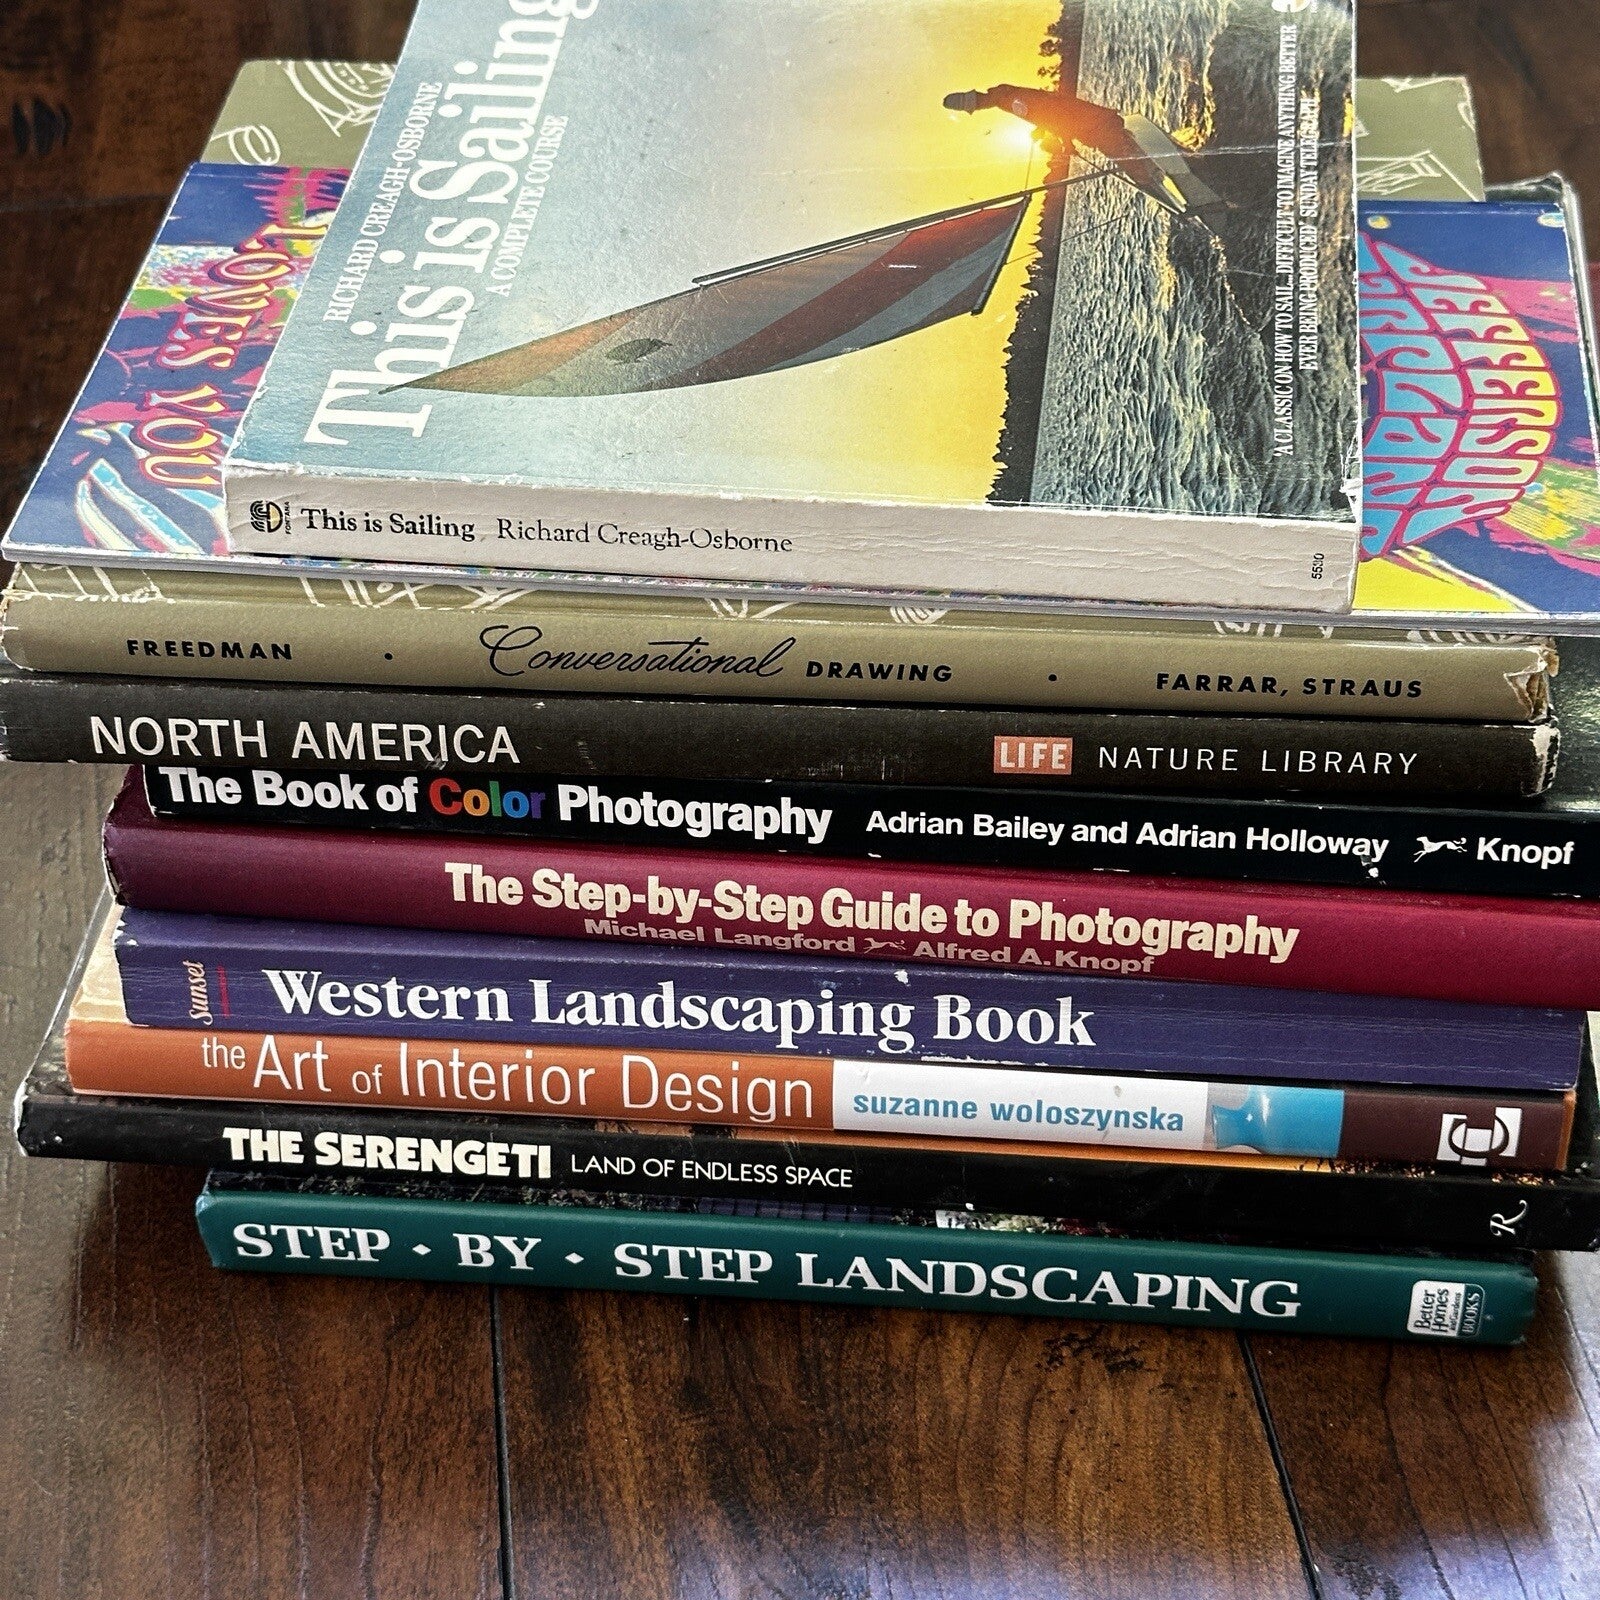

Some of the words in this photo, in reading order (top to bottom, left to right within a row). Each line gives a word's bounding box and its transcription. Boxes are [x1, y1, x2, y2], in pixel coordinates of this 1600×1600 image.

[1279, 24, 1298, 74] BETTER
[1277, 74, 1297, 139] ANYTHING
[525, 115, 570, 184] COURSE
[1299, 98, 1319, 168] TELEGRAPH
[1277, 138, 1296, 192] IMAGINE
[322, 239, 379, 323] RICHARD
[360, 82, 443, 237] CREAGH-OSBORNE
[1276, 191, 1295, 210] TO
[1299, 166, 1318, 218] SUNDAY
[379, 217, 501, 273] is
[490, 186, 547, 281] COMPLETE
[155, 224, 329, 371] LOVES
[486, 286, 511, 297] A
[1299, 290, 1319, 334] BEING
[1274, 333, 1294, 363] HOW
[1275, 312, 1294, 333] TO
[304, 284, 475, 447] This
[1274, 364, 1294, 385] ON
[1299, 334, 1319, 371] EVER
[1273, 386, 1294, 442] CLASSIC
[1374, 241, 1559, 545] JEFFERSON
[136, 383, 228, 487] YOU
[300, 508, 358, 533] This
[364, 513, 382, 533] is
[390, 513, 476, 541] Sailing
[498, 519, 591, 545] Richard
[598, 523, 793, 554] Creagh-Osborne
[127, 638, 293, 661] FREEDMAN
[479, 625, 796, 678] Conversational
[805, 660, 954, 683] DRAWING
[1156, 672, 1290, 697] FARRAR,
[1303, 676, 1424, 699] STRAUS
[90, 714, 269, 758] NORTH
[292, 720, 521, 765] AMERICA
[1000, 739, 1067, 770] LIFE
[1099, 745, 1239, 772] NATURE
[1261, 748, 1418, 776] LIBRARY
[158, 766, 242, 804] The
[252, 769, 369, 811] Book
[376, 776, 419, 813] of
[430, 777, 546, 820] Color
[558, 784, 833, 845] Photography
[866, 810, 963, 835] Adrian
[972, 813, 1065, 846] Bailey
[1071, 820, 1128, 844] and
[1136, 822, 1236, 850] Adrian
[1246, 827, 1390, 862] Holloway
[1477, 837, 1575, 869] Knopf
[445, 862, 524, 905] The
[531, 867, 816, 930] Step-by-Step
[821, 888, 947, 937] Guide
[954, 896, 1001, 940] to
[1008, 898, 1300, 964] Photography
[584, 918, 705, 942] Michael
[714, 926, 856, 952] Langford
[913, 941, 1010, 963] Alfred
[1017, 946, 1050, 967] A.
[1055, 948, 1155, 976] Knopf
[183, 960, 213, 1026] Sunset
[262, 968, 514, 1022] Western
[529, 978, 915, 1053] Landscaping
[934, 995, 1096, 1048] Book
[201, 1037, 247, 1071] the
[252, 1034, 330, 1094] Art
[352, 1065, 383, 1095] of
[399, 1042, 596, 1106] Interior
[621, 1055, 815, 1125] Design
[853, 1091, 978, 1120] suzanne
[990, 1099, 1185, 1132] woloszynska
[223, 1127, 304, 1164] THE
[314, 1131, 551, 1180] SERENGETI
[571, 1152, 636, 1177] LAND
[642, 1157, 674, 1179] OF
[681, 1159, 777, 1185] ENDLESS
[784, 1165, 853, 1189] SPACE
[232, 1224, 391, 1263] STEP
[452, 1232, 541, 1271] BY
[614, 1244, 774, 1284] STEP
[796, 1252, 1302, 1317] LANDSCAPING
[1414, 1289, 1437, 1331] Better
[1431, 1288, 1449, 1334] Homes
[1462, 1291, 1481, 1333] BOOKS
